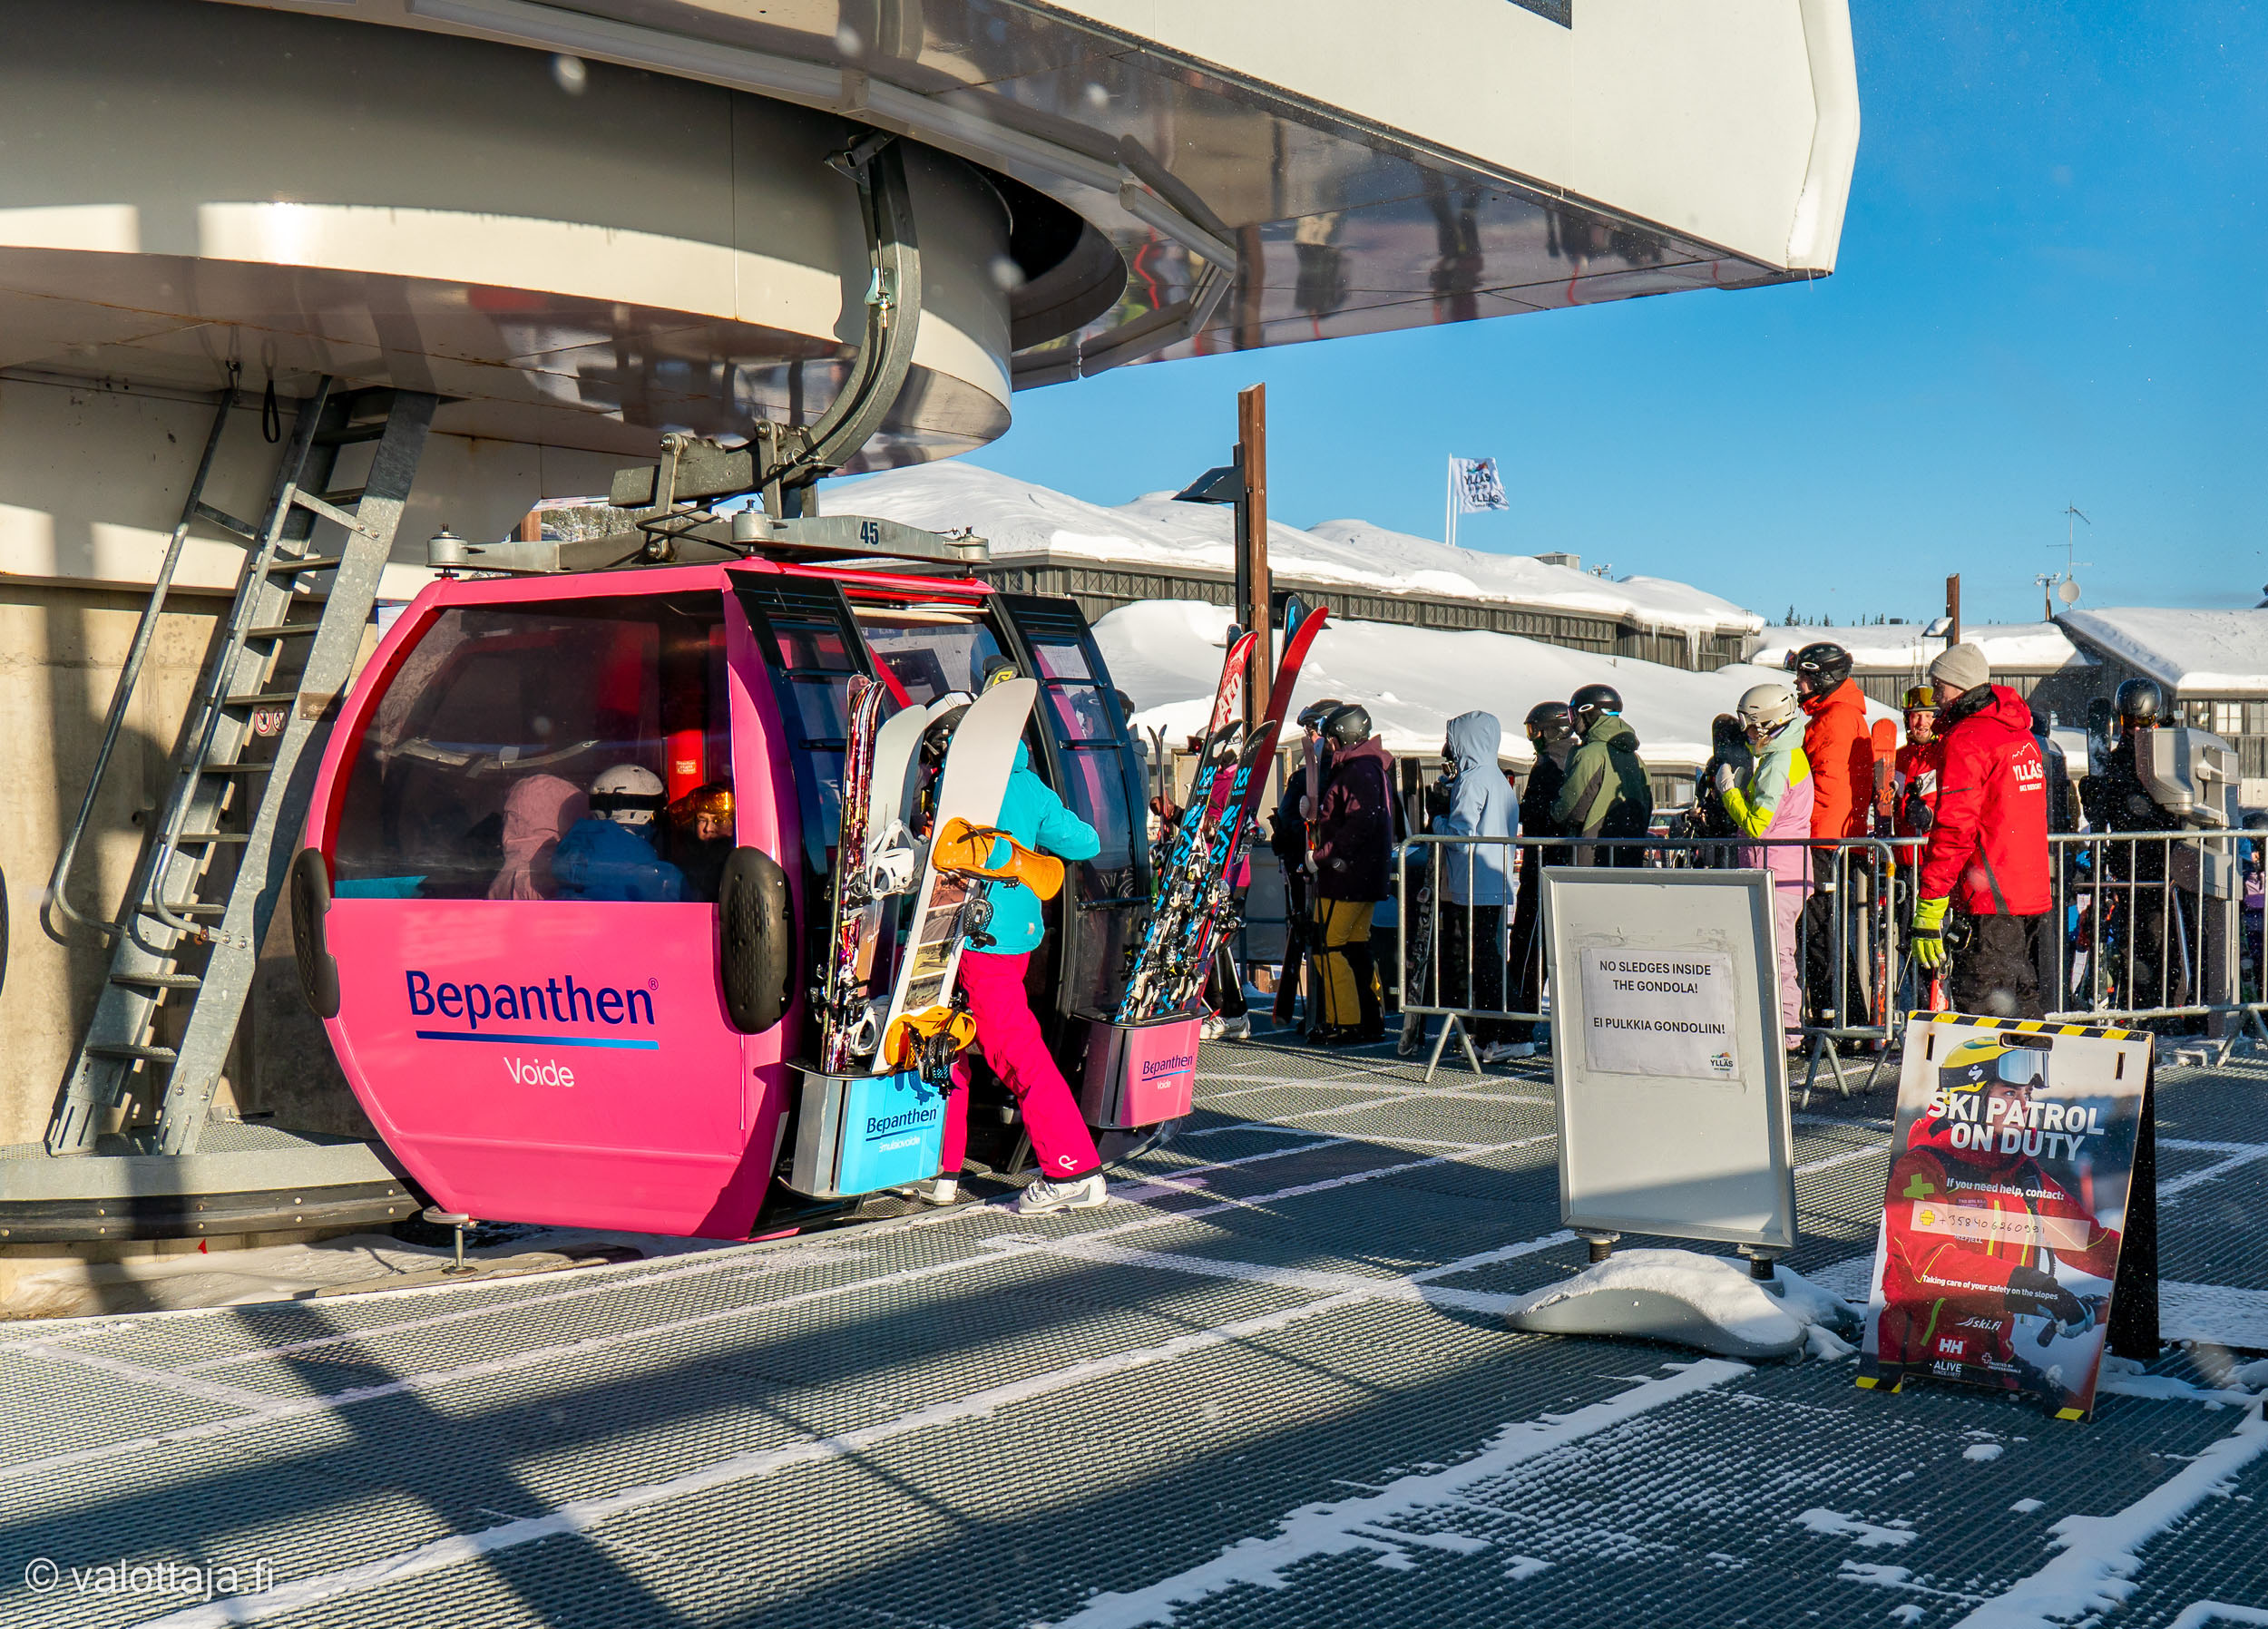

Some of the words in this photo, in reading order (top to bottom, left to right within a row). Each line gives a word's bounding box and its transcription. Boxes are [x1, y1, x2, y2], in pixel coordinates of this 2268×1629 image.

[860, 521, 878, 544] 45
[2013, 760, 2043, 781] YLLÄS
[1599, 961, 1617, 971] NO
[1618, 961, 1670, 973] SLEDGES
[1672, 963, 1712, 975] INSIDE
[1613, 980, 1634, 990] THE
[1637, 980, 1698, 993] GONDOLA!
[1593, 1018, 1603, 1028] EI
[1606, 1018, 1652, 1030] PULKKIA
[1654, 1021, 1725, 1034] GONDOLIIN!
[503, 1057, 574, 1088] Voide
[1143, 1055, 1193, 1075] Bepanthen
[1710, 1058, 1734, 1068] YLLÄS
[866, 1108, 936, 1134] Bepanthen
[1927, 1090, 1980, 1122] SKI
[1985, 1097, 2105, 1135] PATROL
[1950, 1122, 1994, 1152] ON
[2000, 1127, 2086, 1161] DUTY
[1946, 1177, 1955, 1187] If
[1955, 1181, 1973, 1191] you
[1974, 1183, 1999, 1193] need
[1999, 1184, 2024, 1197] help,
[2026, 1188, 2065, 1201] contact:
[1922, 1274, 1946, 1287] Taking
[1946, 1280, 1962, 1288] care
[1962, 1281, 1971, 1289] of
[1970, 1283, 1988, 1291] your
[1988, 1284, 2011, 1295] safety
[2021, 1289, 2033, 1297] the
[2034, 1290, 2058, 1300] slopes
[1972, 1319, 2003, 1331] ski.fi
[1939, 1338, 1964, 1355] HH
[1933, 1361, 1962, 1373] ALIVE
